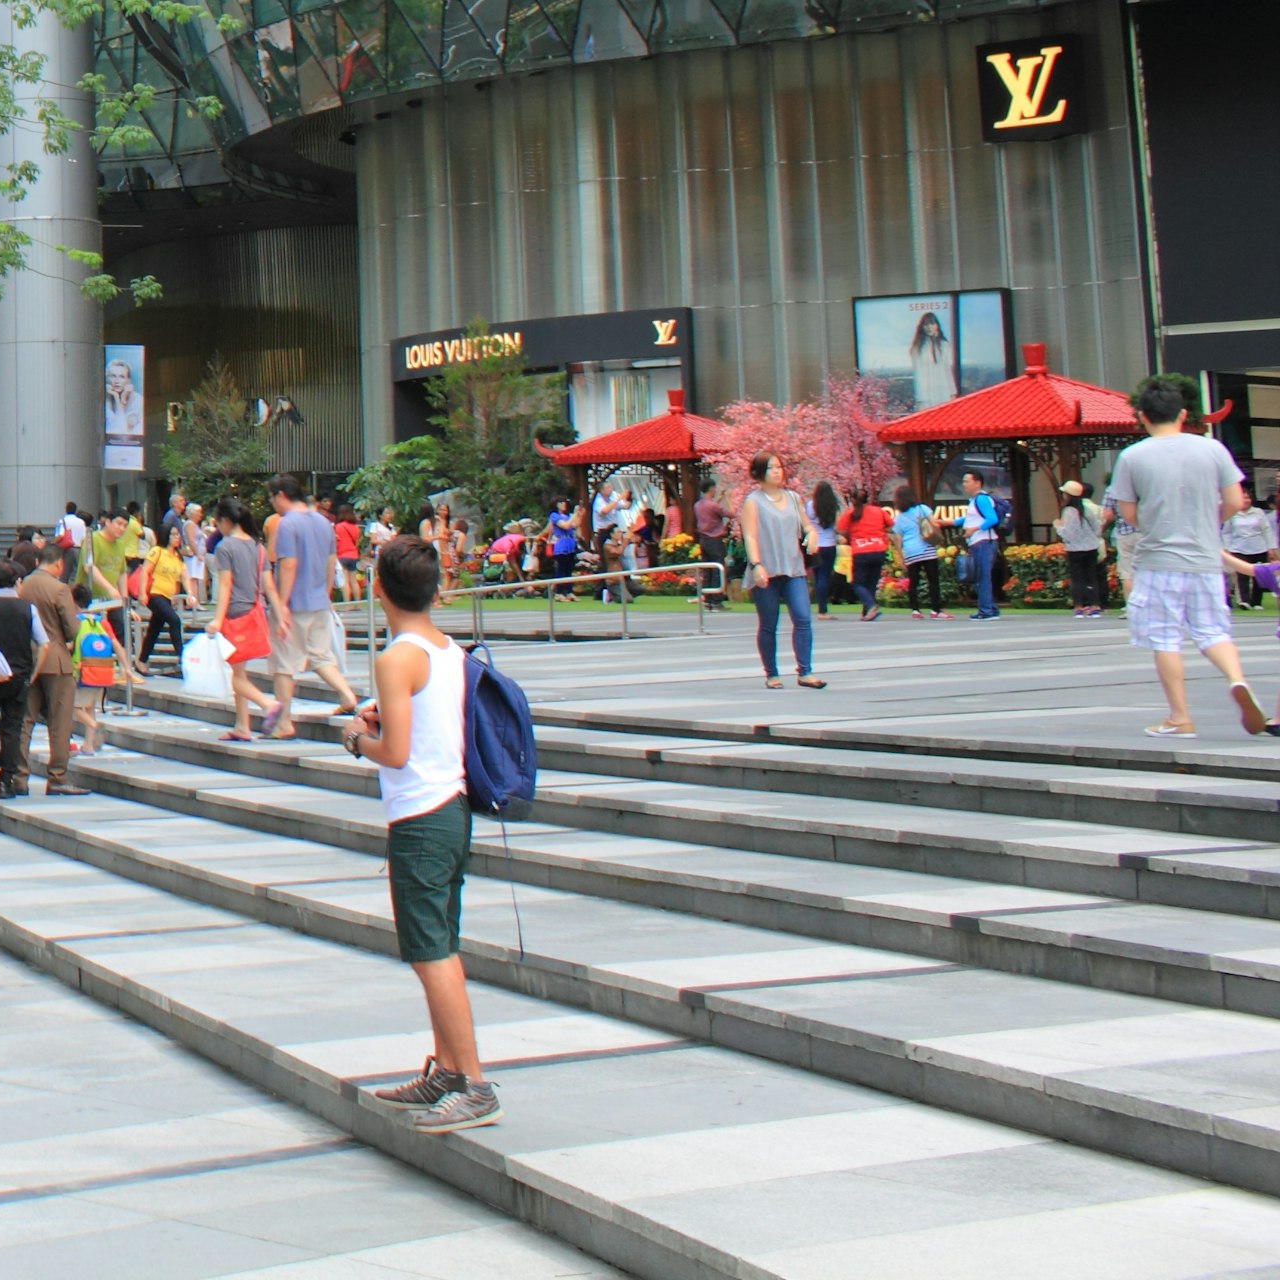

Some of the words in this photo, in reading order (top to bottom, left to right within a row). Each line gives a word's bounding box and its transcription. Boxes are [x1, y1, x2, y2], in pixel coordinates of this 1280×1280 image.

[909, 302, 941, 312] SERIES
[942, 301, 949, 310] 2
[405, 340, 443, 370] LOUIS
[443, 331, 522, 364] VUITTON
